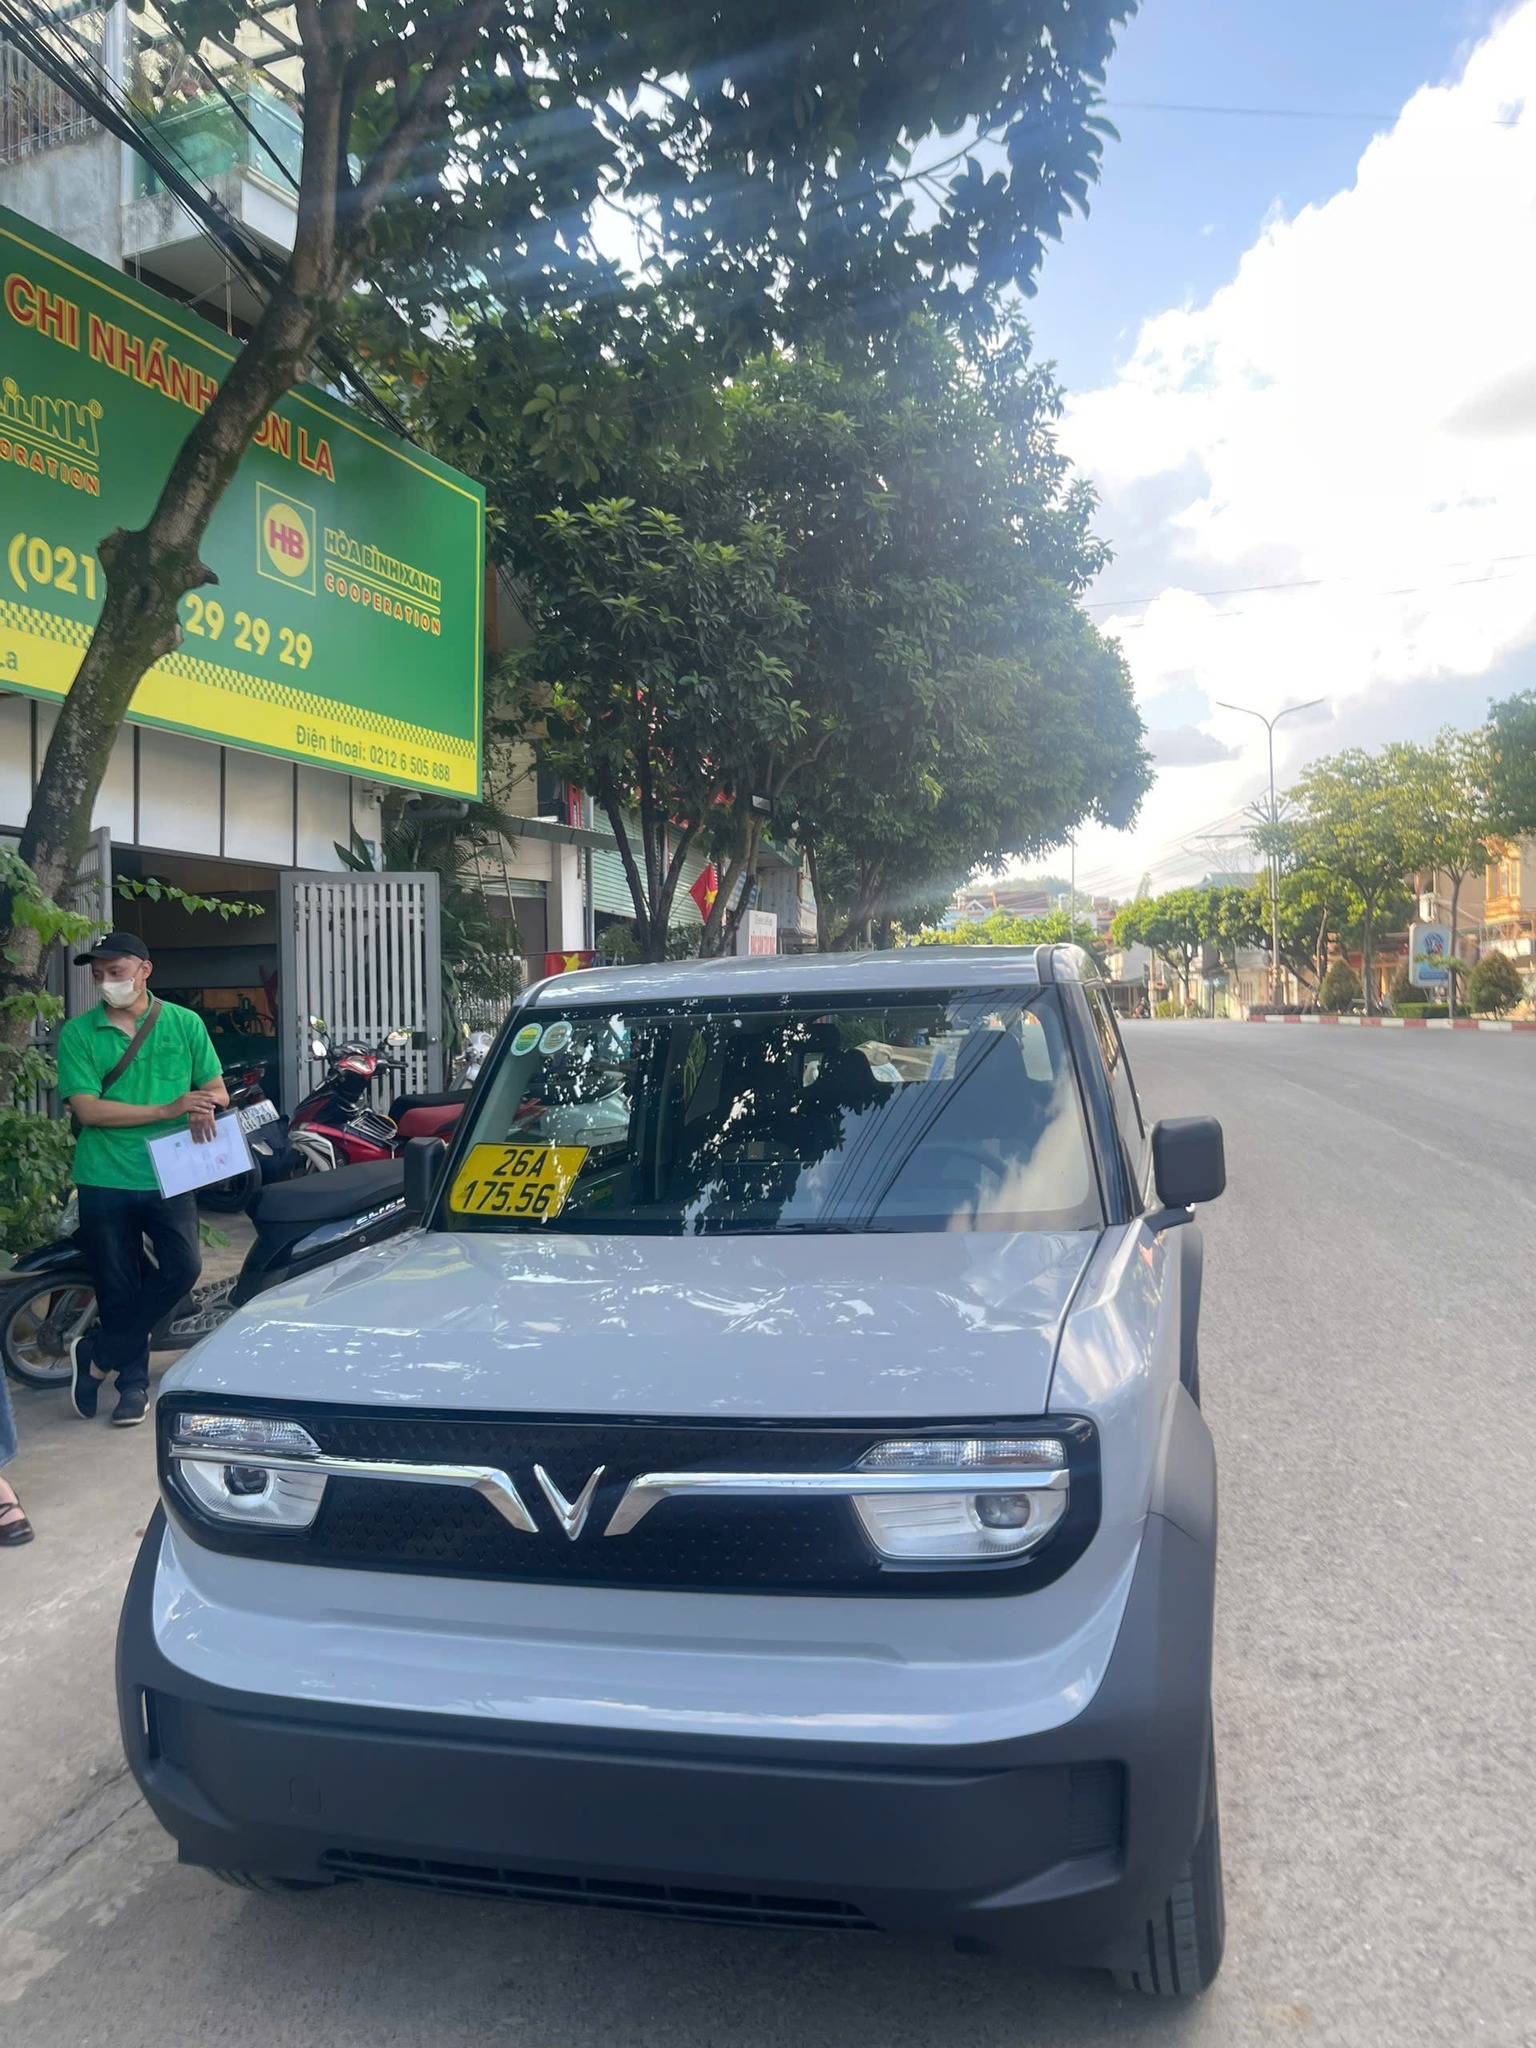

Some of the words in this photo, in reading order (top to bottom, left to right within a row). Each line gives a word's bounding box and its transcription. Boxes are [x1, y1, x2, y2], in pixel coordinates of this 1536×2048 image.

[4, 273, 80, 351] CHI
[89, 312, 218, 415] NHÁNH
[297, 426, 336, 483] LA
[268, 518, 305, 560] HB
[323, 527, 361, 567] HÒA
[362, 544, 400, 584] BÌNH
[400, 562, 441, 602] XANH
[8, 532, 98, 601] (021
[185, 593, 225, 640] 29
[234, 611, 271, 656] 29
[279, 627, 313, 670] 29
[324, 572, 441, 636] COOPERATION
[296, 724, 327, 753] Điện
[330, 735, 366, 762] thoại:
[369, 745, 397, 769] 0212
[400, 753, 407, 771] 6
[410, 756, 429, 777] 505
[432, 762, 451, 782] 888
[493, 1149, 548, 1178] 26A
[462, 1180, 556, 1214] 175.56
